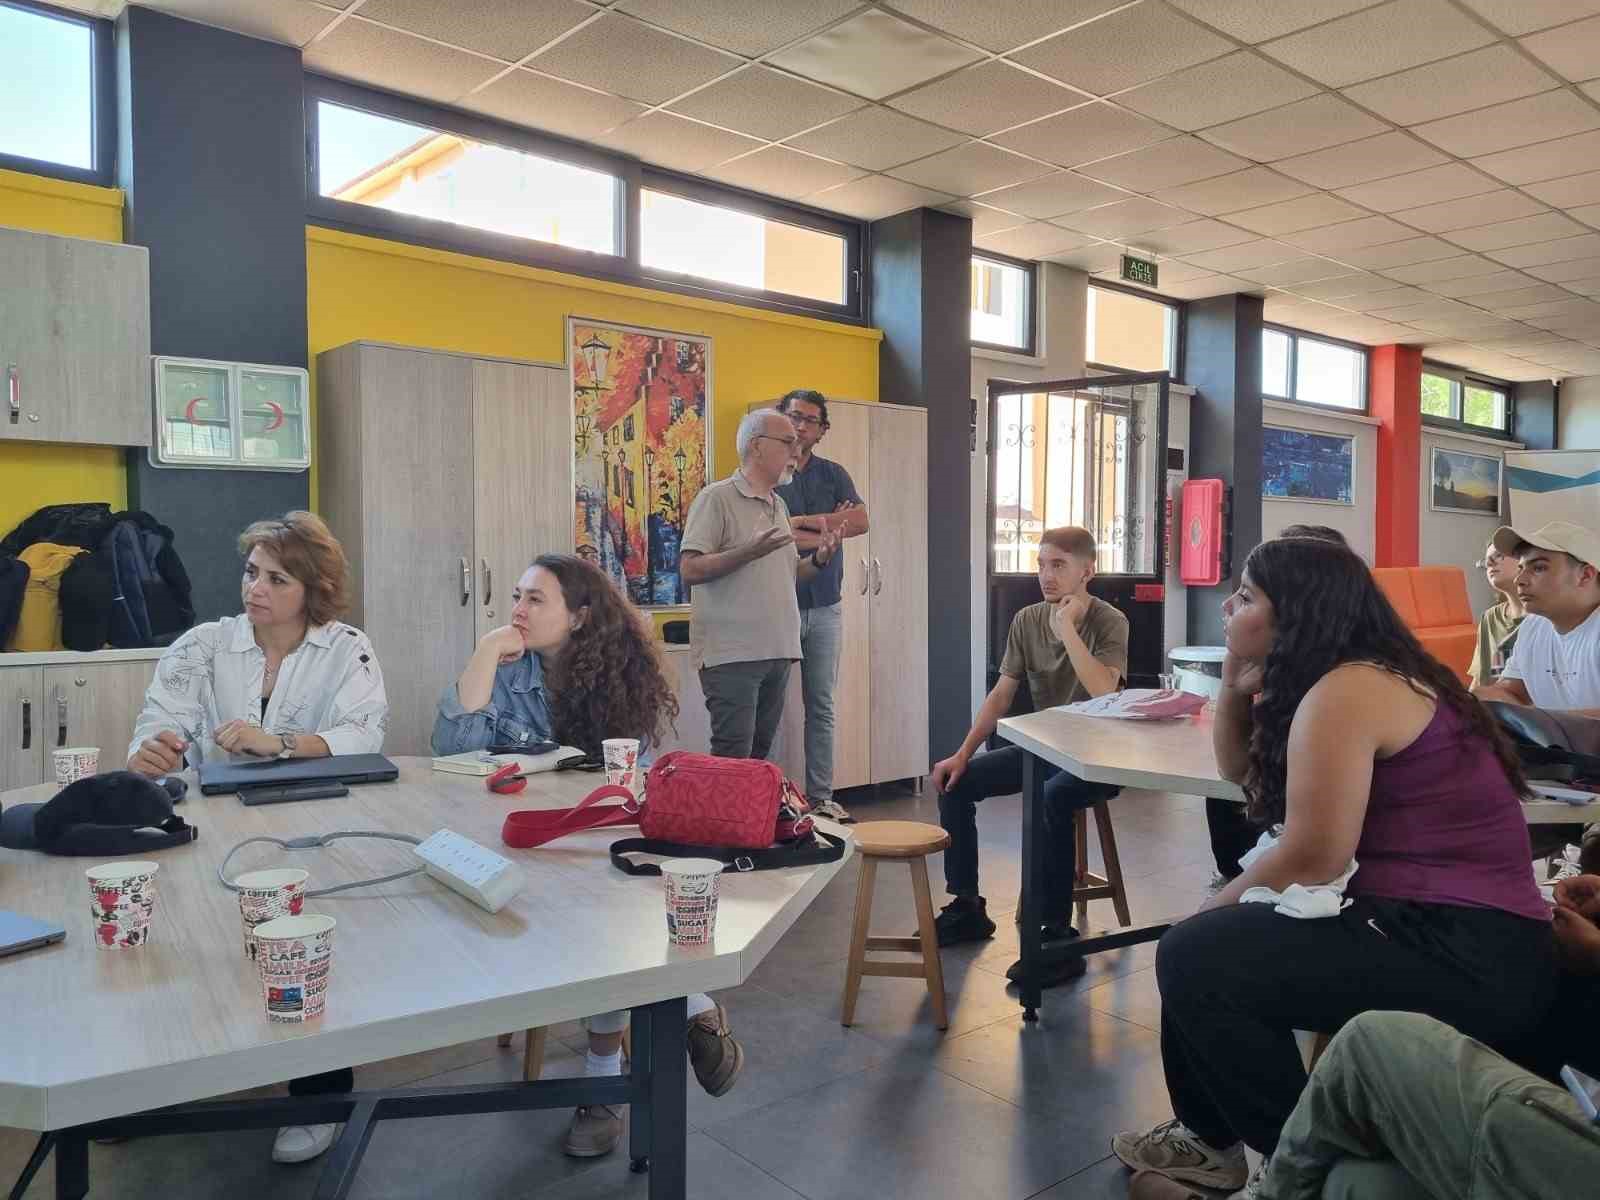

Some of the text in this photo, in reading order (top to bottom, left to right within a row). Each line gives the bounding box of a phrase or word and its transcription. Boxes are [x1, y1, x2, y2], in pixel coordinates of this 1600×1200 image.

[677, 919, 707, 927] SUGAR
[271, 940, 306, 952] TEA
[269, 951, 306, 961] CAFE
